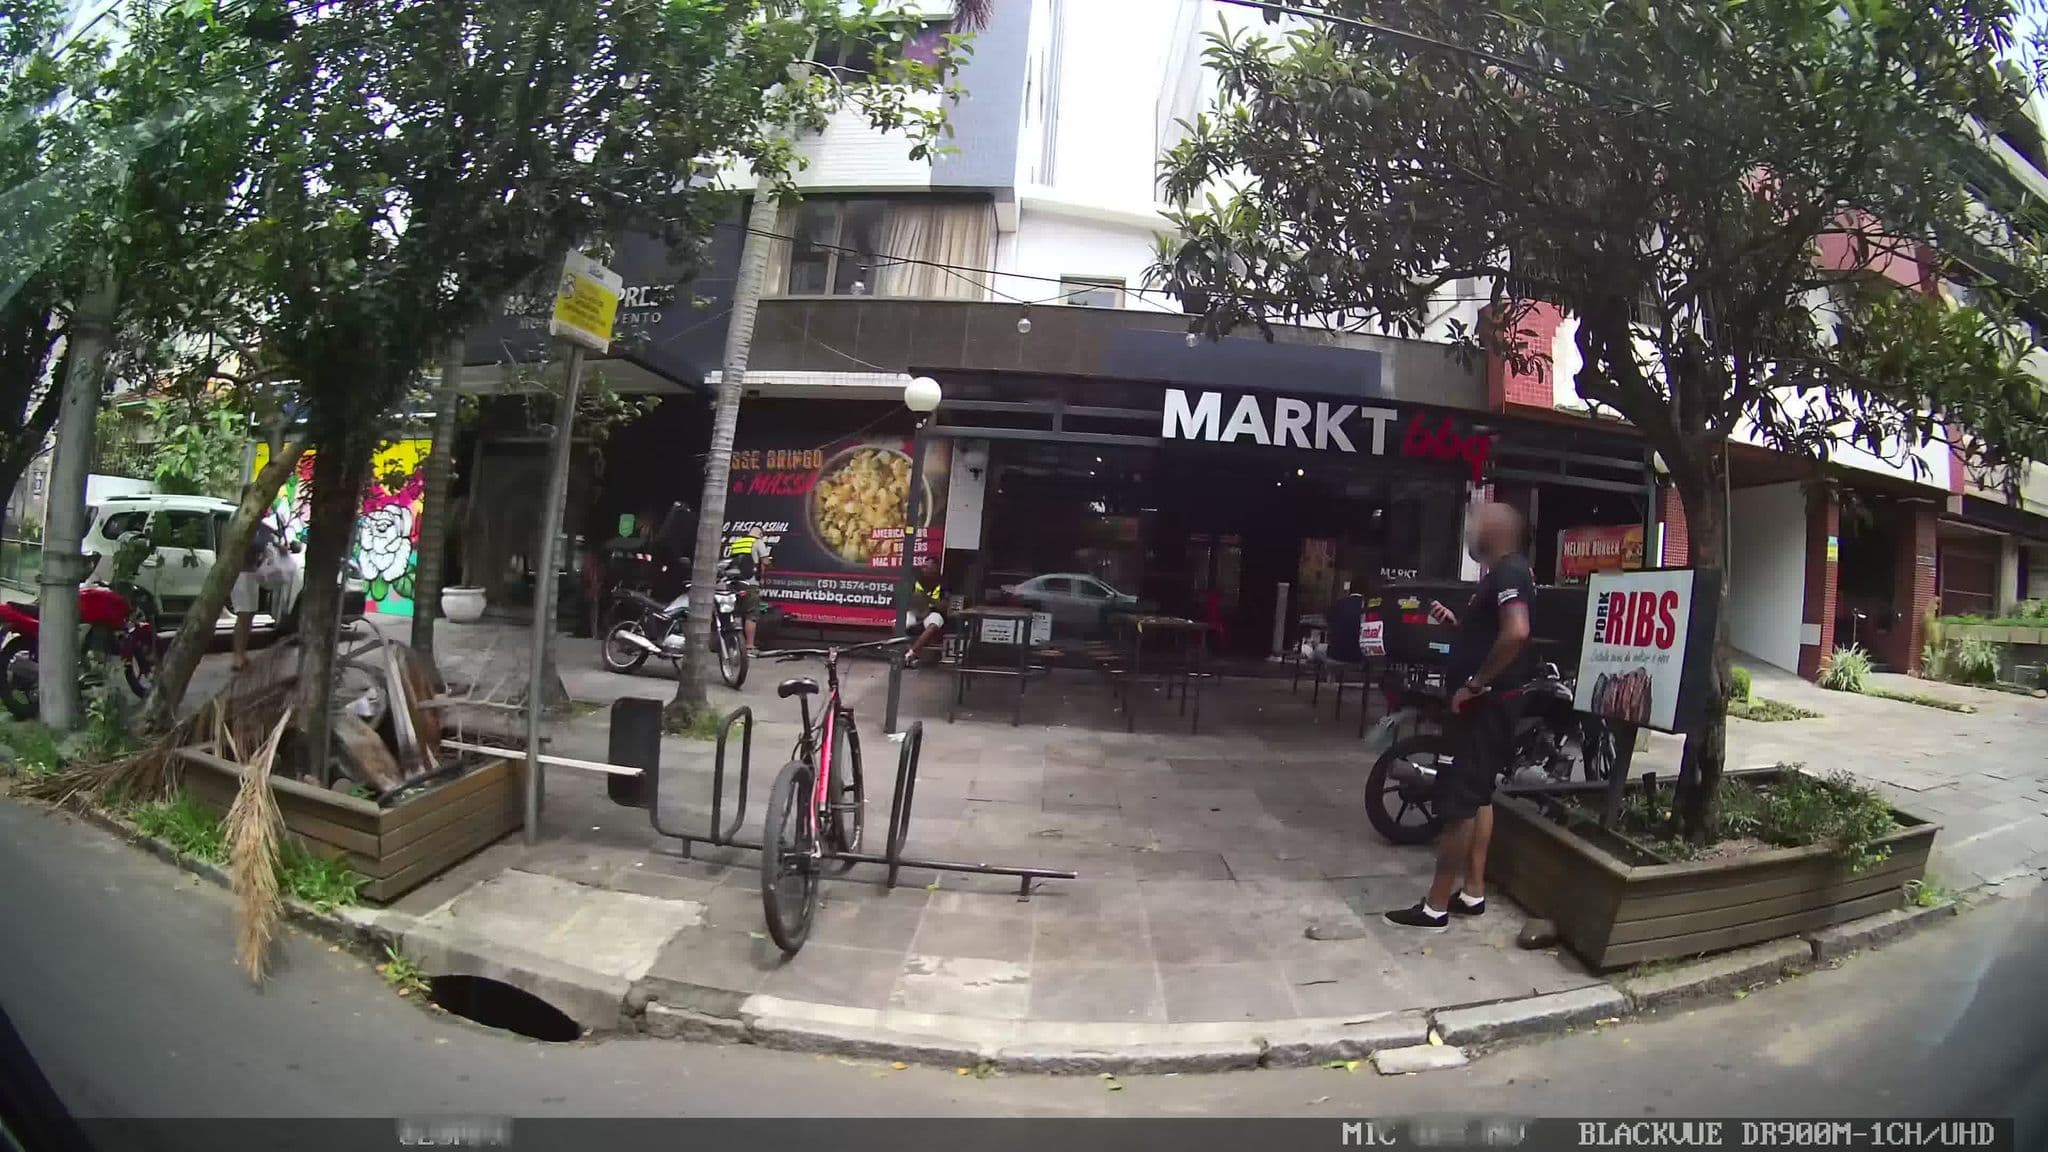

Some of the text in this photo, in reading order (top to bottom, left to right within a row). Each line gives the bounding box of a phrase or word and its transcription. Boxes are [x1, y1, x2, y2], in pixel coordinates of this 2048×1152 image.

[615, 311, 662, 325] ENTO
[1162, 388, 1491, 487] MARKT bbq
[731, 450, 760, 470] SSE
[732, 521, 755, 532] FAST
[872, 528, 905, 538] AMERICA
[817, 579, 837, 590] (51)
[840, 580, 894, 593] 3574-0154
[757, 587, 893, 606] ww.marktbbq.com.br
[1594, 591, 1610, 644] PORK
[1605, 590, 1679, 650] RIBS
